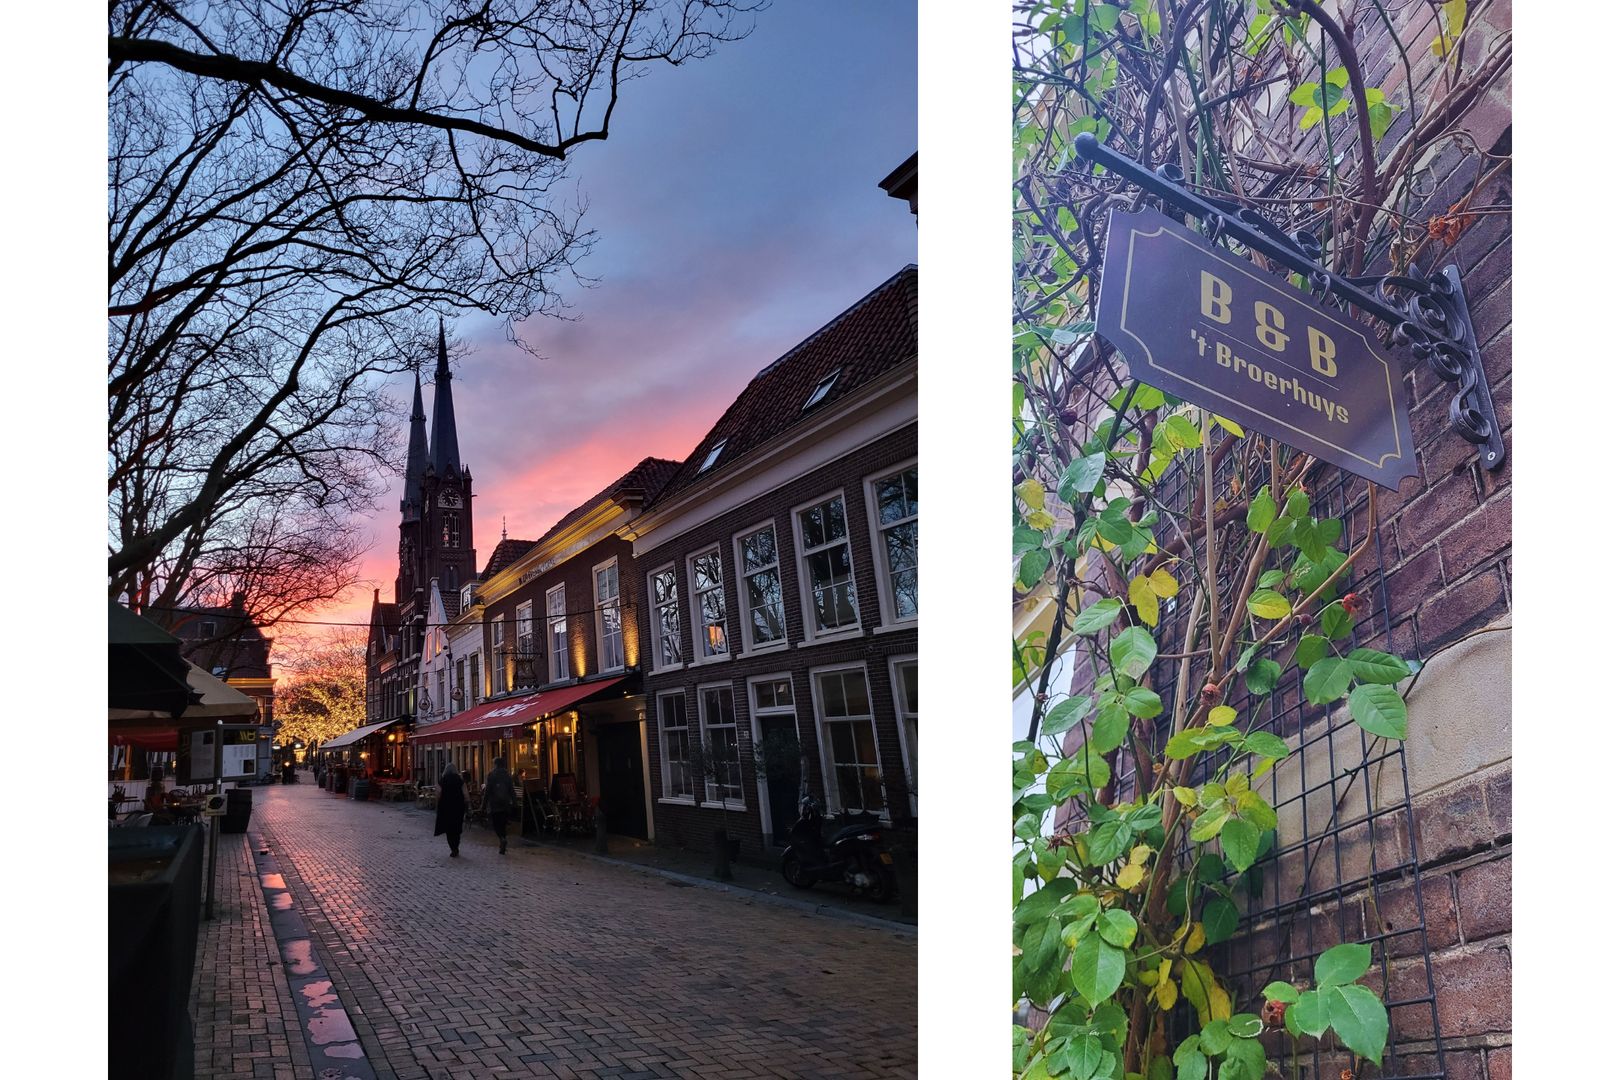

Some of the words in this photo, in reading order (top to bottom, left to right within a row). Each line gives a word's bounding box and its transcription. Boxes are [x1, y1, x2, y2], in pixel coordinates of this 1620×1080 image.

[1200, 269, 1233, 324] B
[1254, 300, 1290, 352] &
[1307, 325, 1338, 378] B
[1190, 328, 1207, 357] 't
[1216, 341, 1349, 424] Broerhuys
